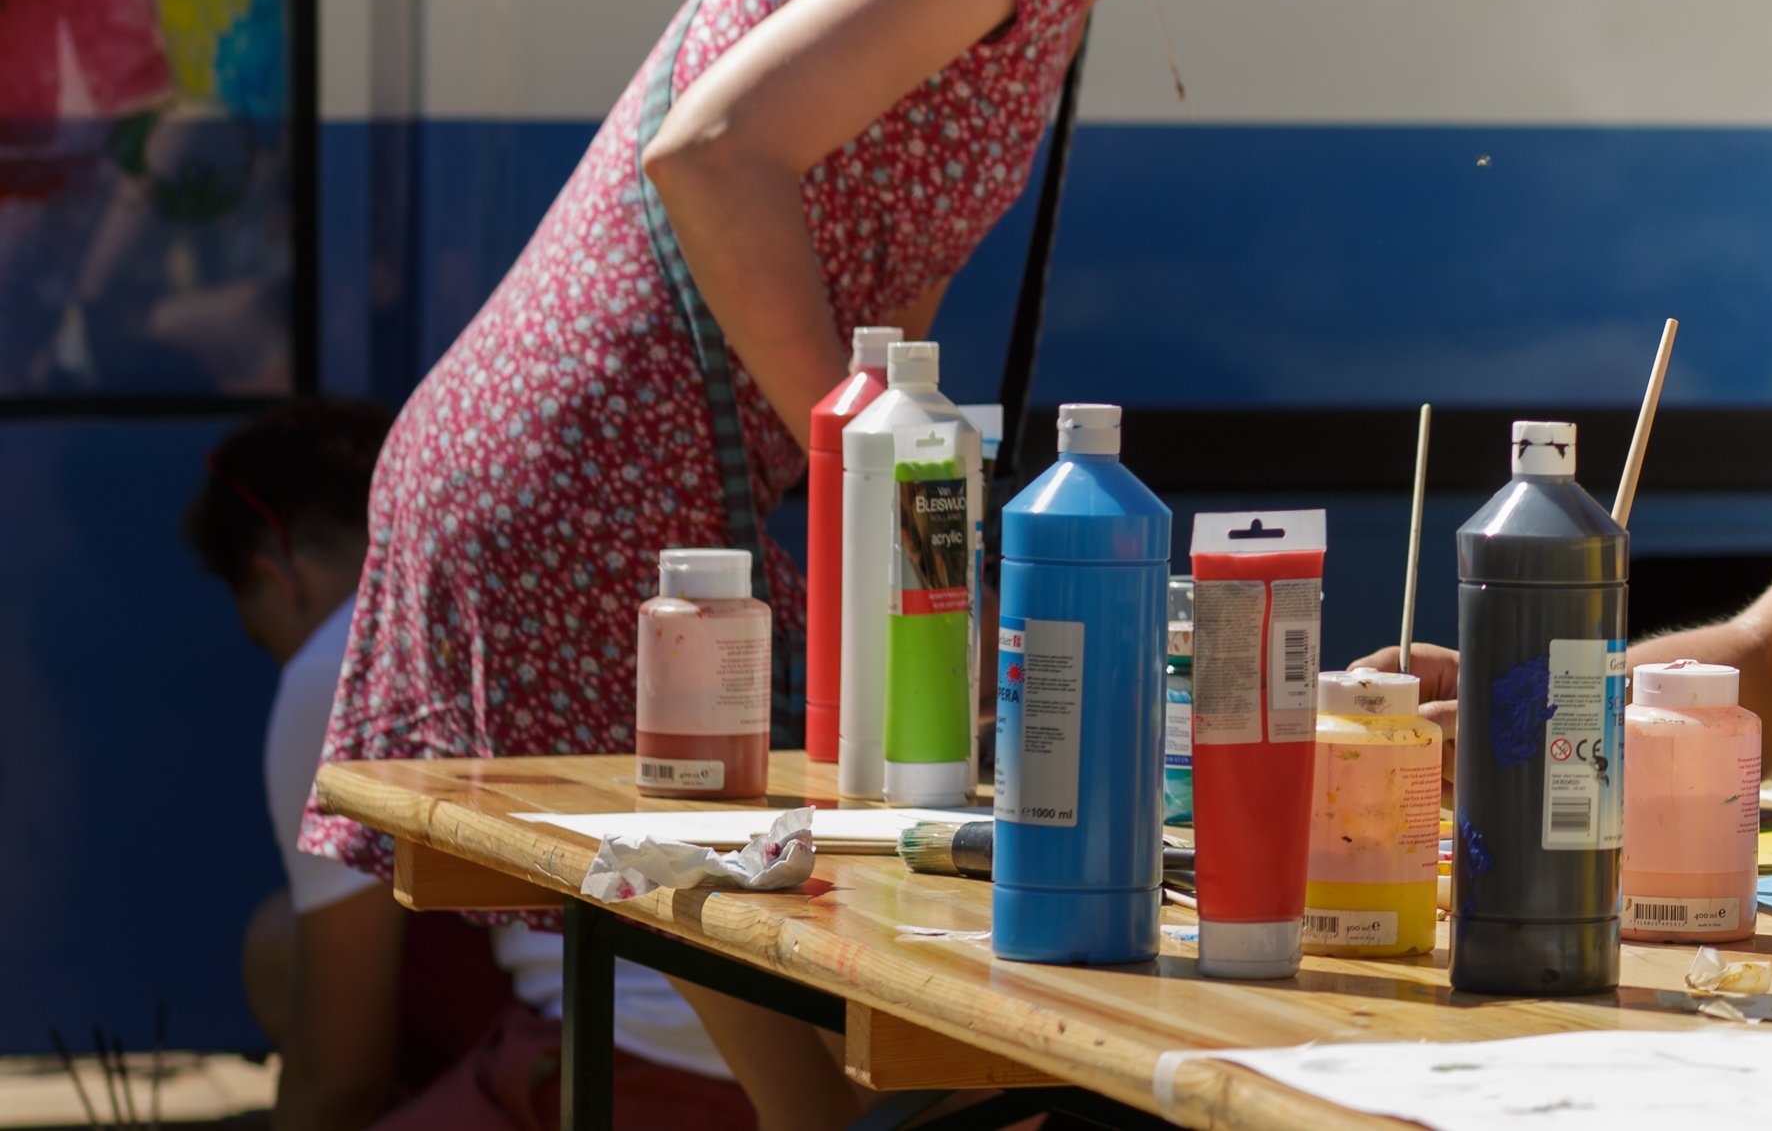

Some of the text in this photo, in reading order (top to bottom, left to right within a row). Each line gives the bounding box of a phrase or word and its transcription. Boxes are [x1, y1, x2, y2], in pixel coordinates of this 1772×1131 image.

[931, 530, 962, 548] acrylic
[1031, 807, 1056, 819] 1000
[1058, 808, 1073, 820] ml
[1693, 912, 1708, 921] 400
